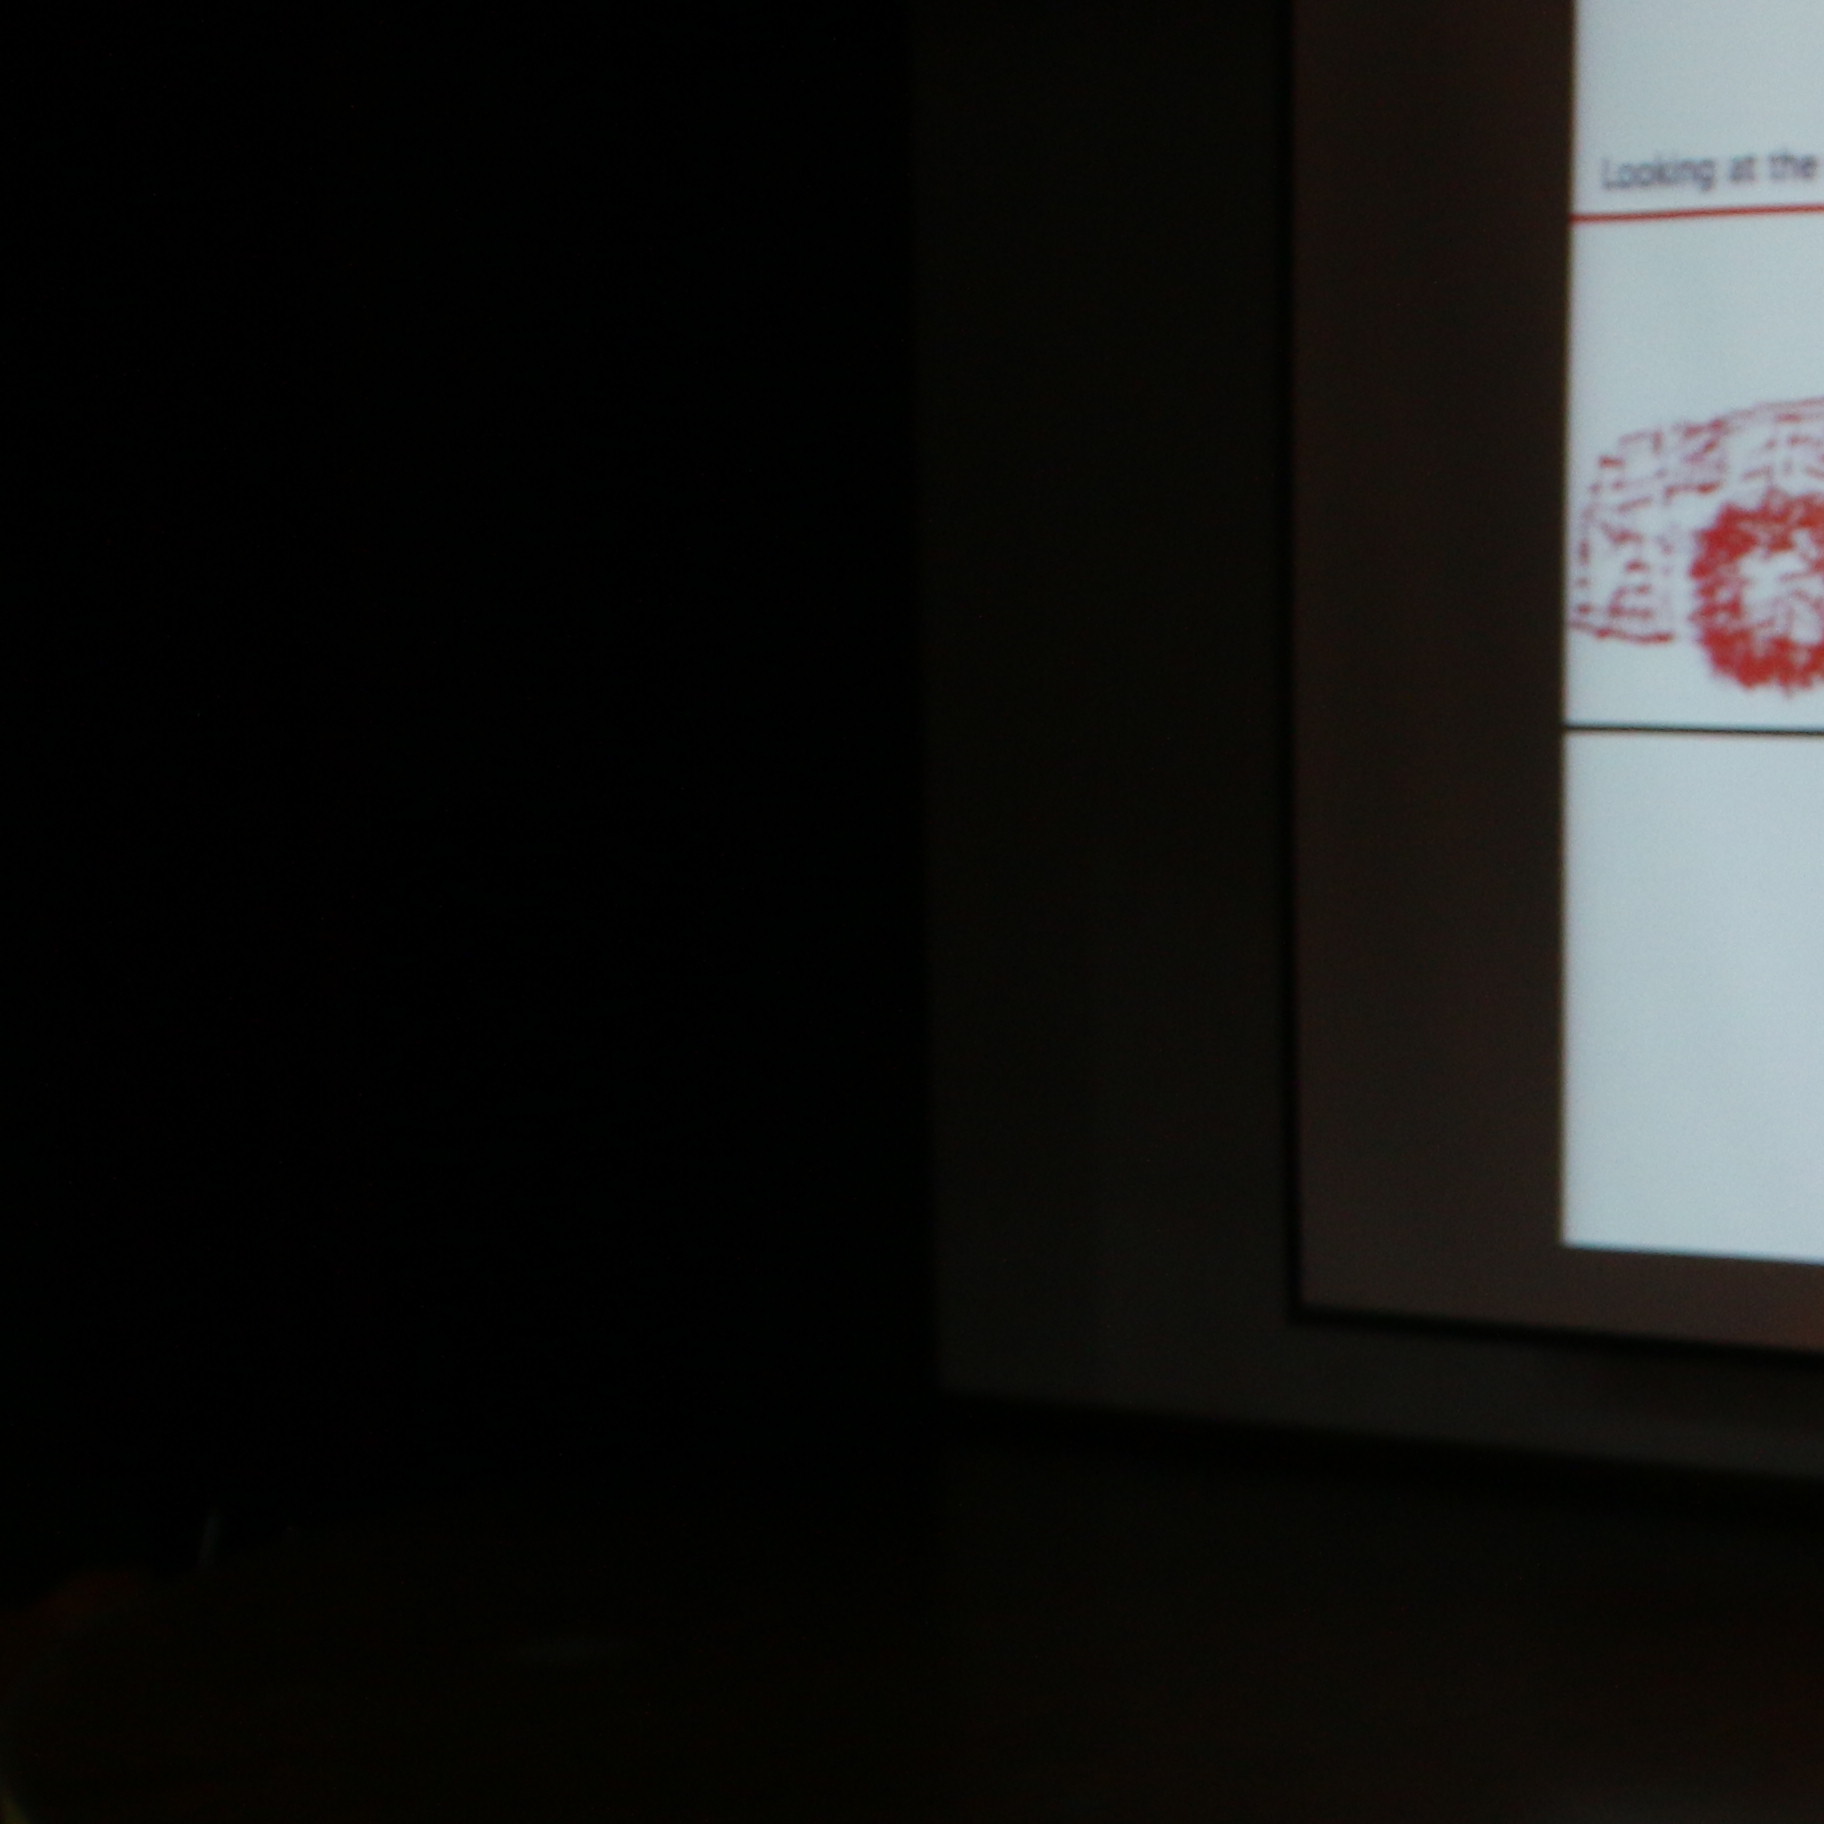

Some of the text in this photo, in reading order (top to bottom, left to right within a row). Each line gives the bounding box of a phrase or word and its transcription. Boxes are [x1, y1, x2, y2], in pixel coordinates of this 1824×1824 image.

[1602, 155, 1716, 192] Looking
[1730, 154, 1756, 182] at
[1770, 148, 1817, 180] the
